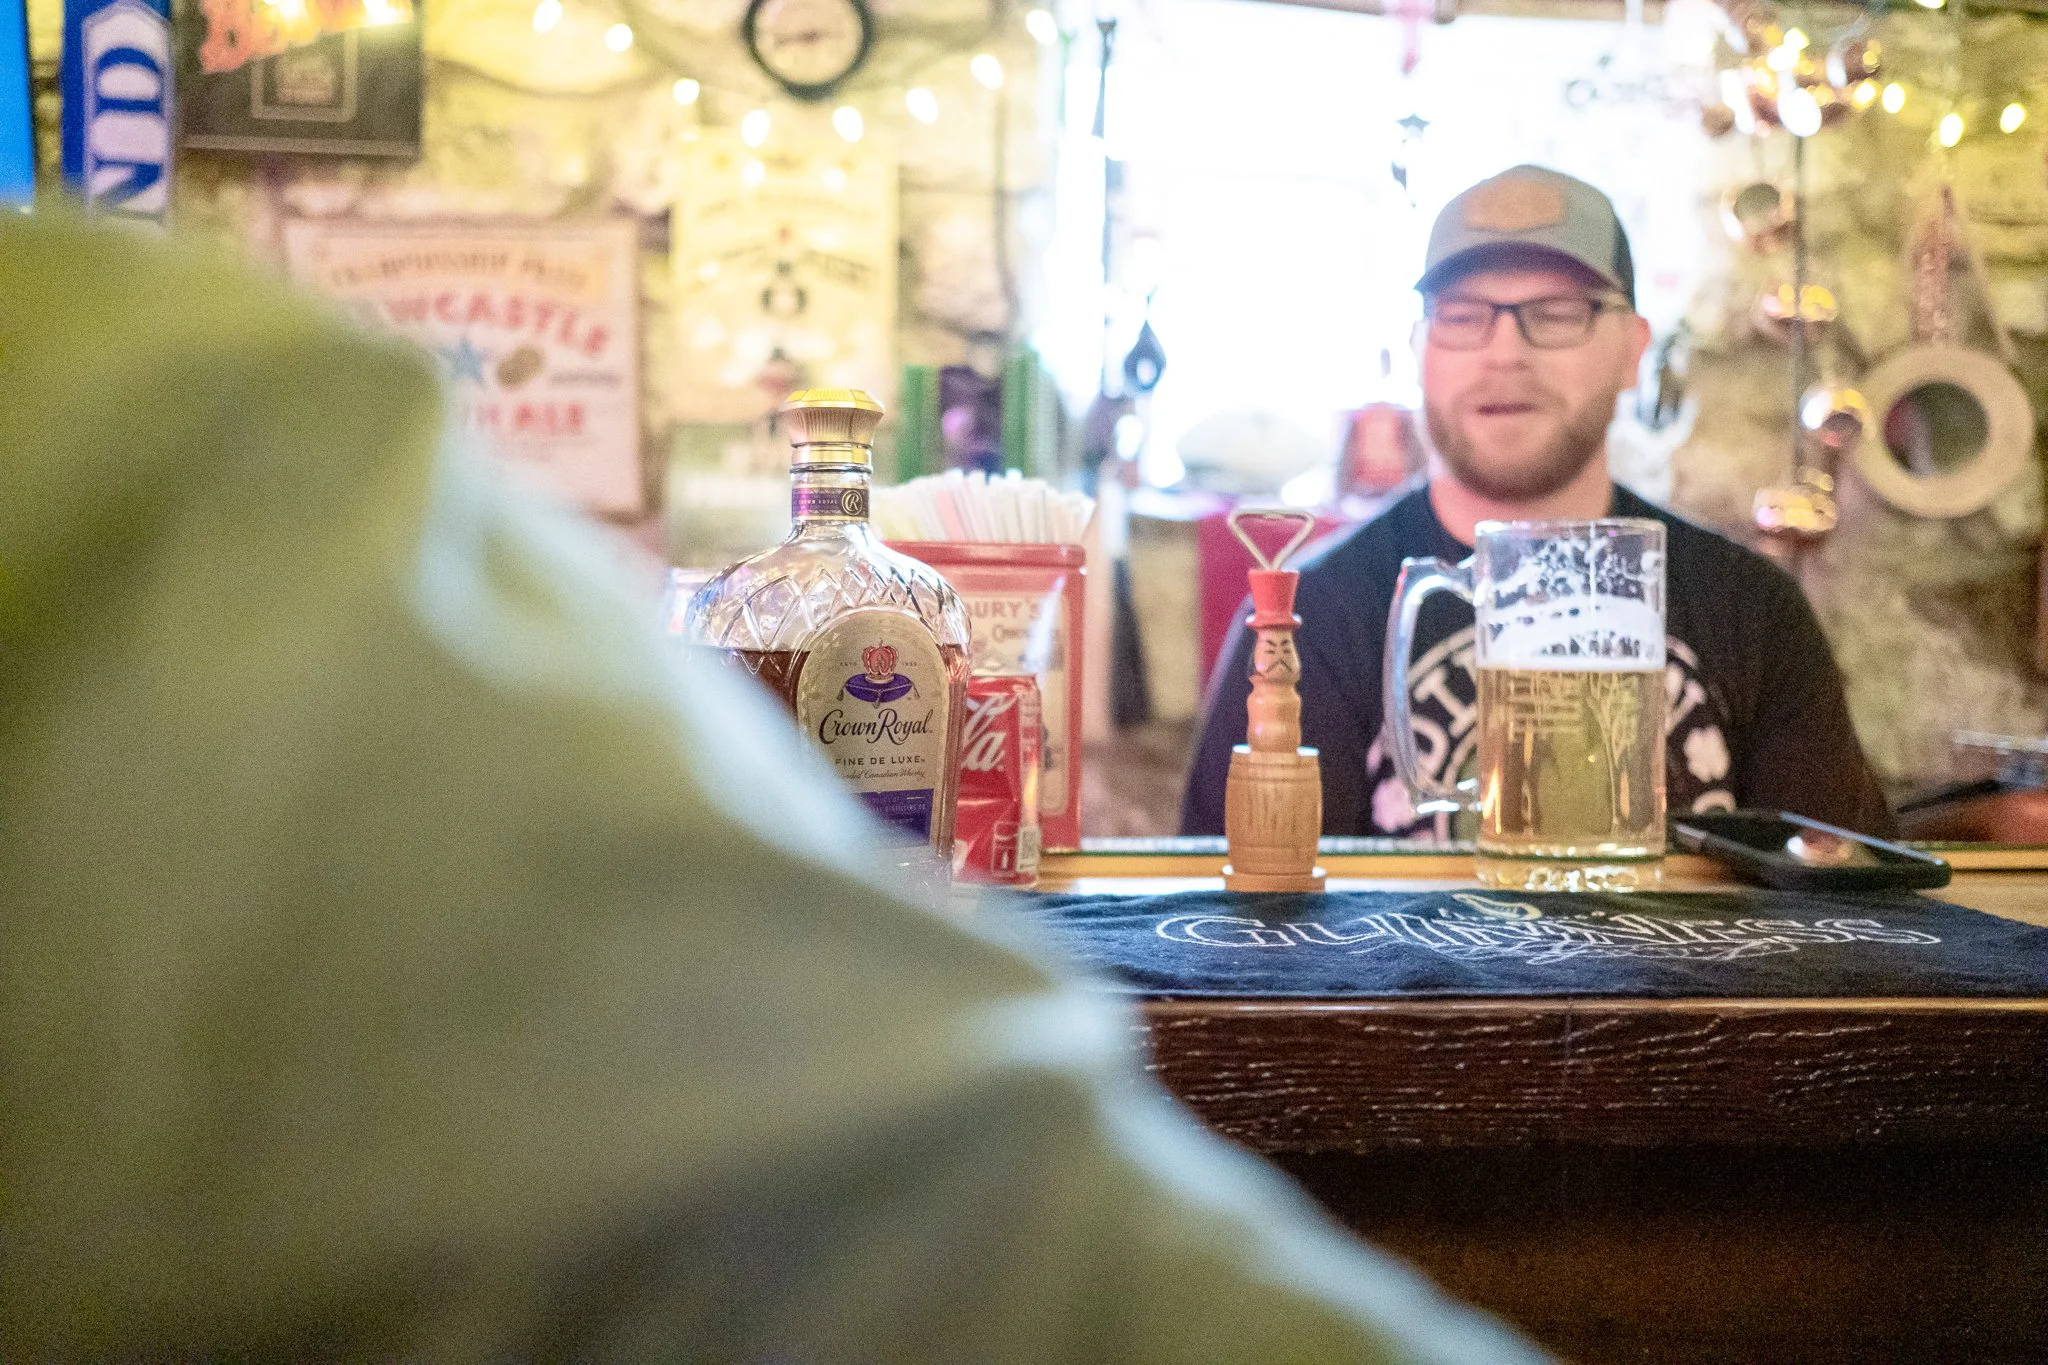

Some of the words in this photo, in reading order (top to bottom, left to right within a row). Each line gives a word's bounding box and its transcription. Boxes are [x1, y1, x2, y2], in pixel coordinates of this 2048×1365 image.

[967, 600, 1040, 619] URY'S
[819, 708, 877, 745] Crown
[867, 708, 934, 746] Royal
[835, 757, 865, 766] FINE
[870, 757, 885, 765] DE
[891, 755, 921, 764] LUXE
[1155, 912, 1942, 948] GUINNESS
